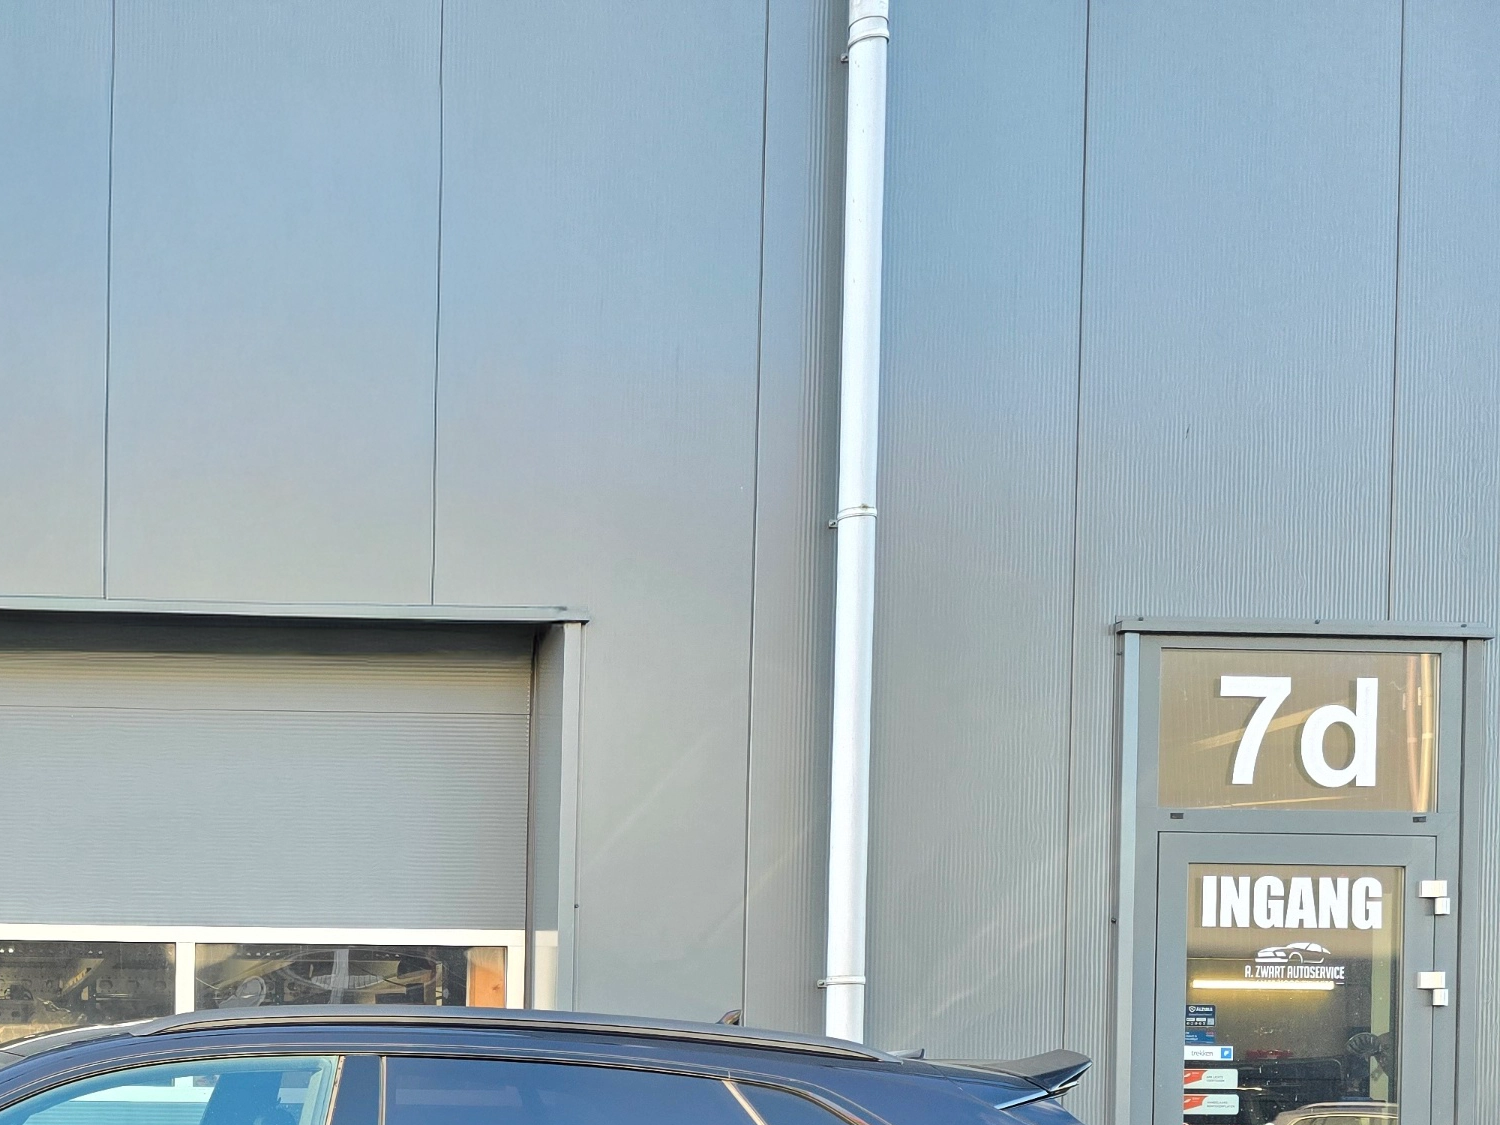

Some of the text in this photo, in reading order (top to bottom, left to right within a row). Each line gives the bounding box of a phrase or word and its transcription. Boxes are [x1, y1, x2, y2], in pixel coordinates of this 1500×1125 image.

[1220, 675, 1378, 788] 7d
[1202, 875, 1382, 930] INGANG
[1255, 965, 1286, 978] ZWART
[1287, 965, 1345, 980] AUTOSERVICE
